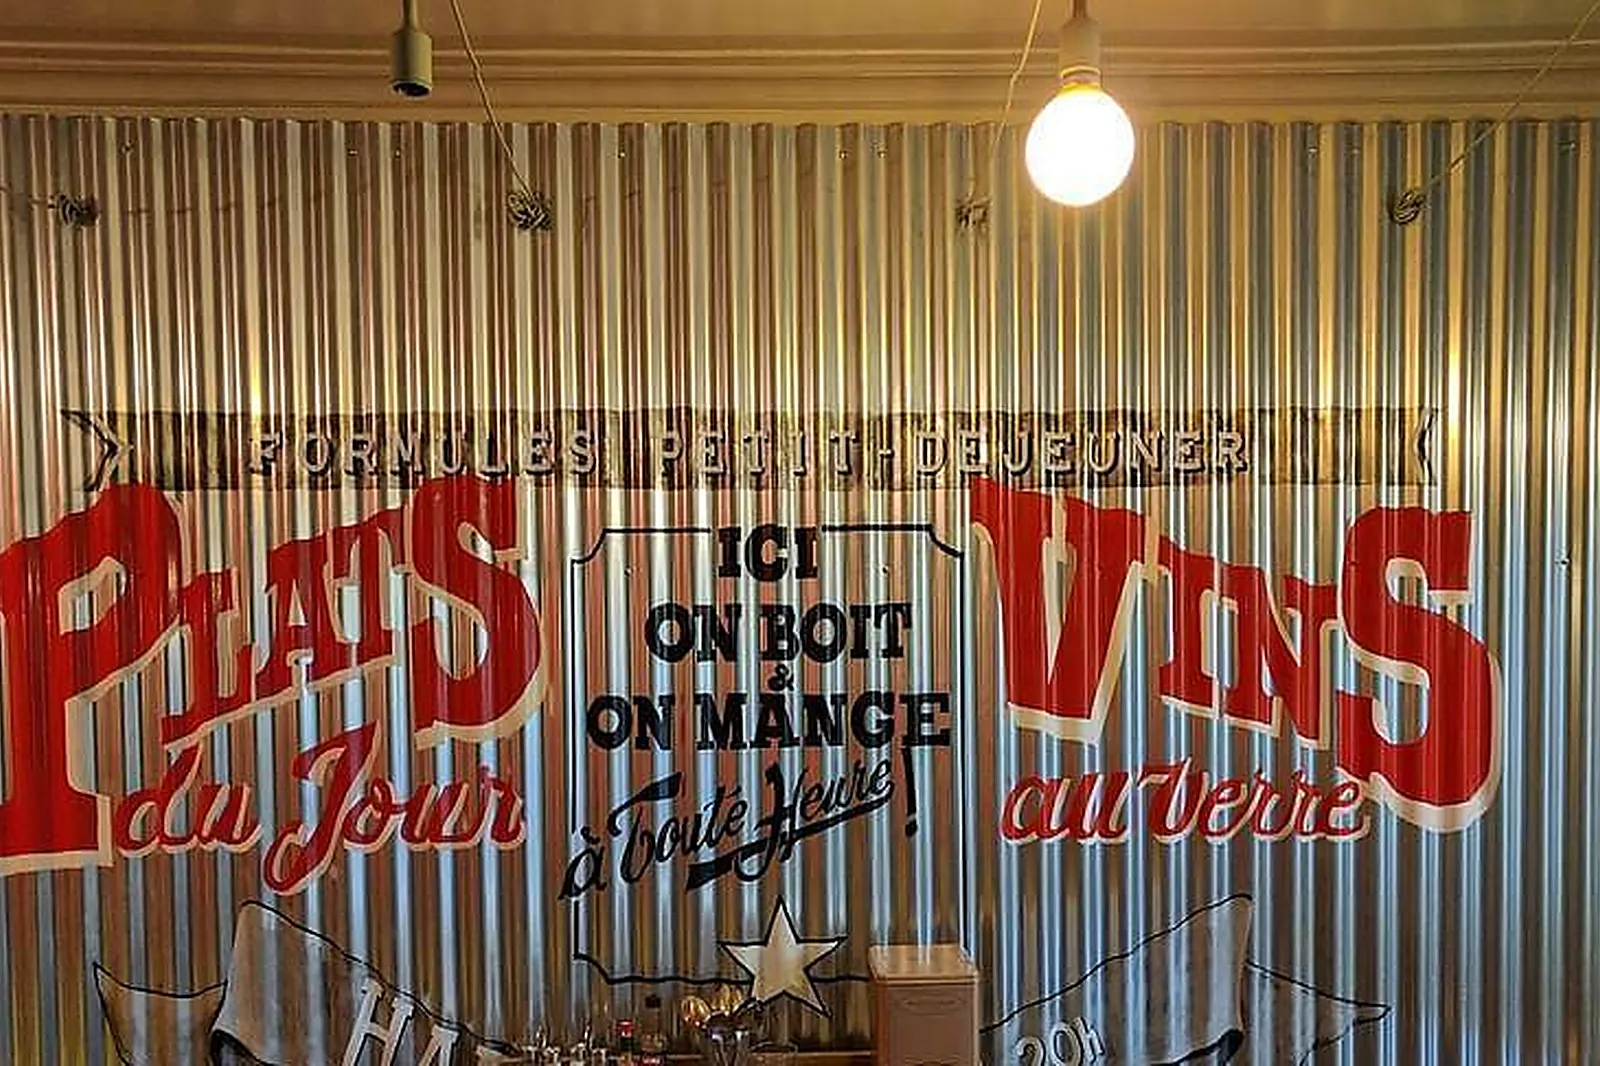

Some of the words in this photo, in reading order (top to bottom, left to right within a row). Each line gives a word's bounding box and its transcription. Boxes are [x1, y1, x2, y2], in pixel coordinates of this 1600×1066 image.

[249, 430, 598, 477] FORMULES
[717, 523, 819, 582] ICI
[644, 602, 742, 662] ON
[760, 602, 914, 661] BOIT
[969, 475, 1502, 833] VINS
[0, 474, 550, 874] PLATS
[768, 662, 796, 692] &
[587, 694, 675, 751] ON
[695, 690, 952, 750] MANGE
[114, 738, 263, 858] du
[262, 718, 526, 896] Jour
[1001, 766, 1134, 844] au
